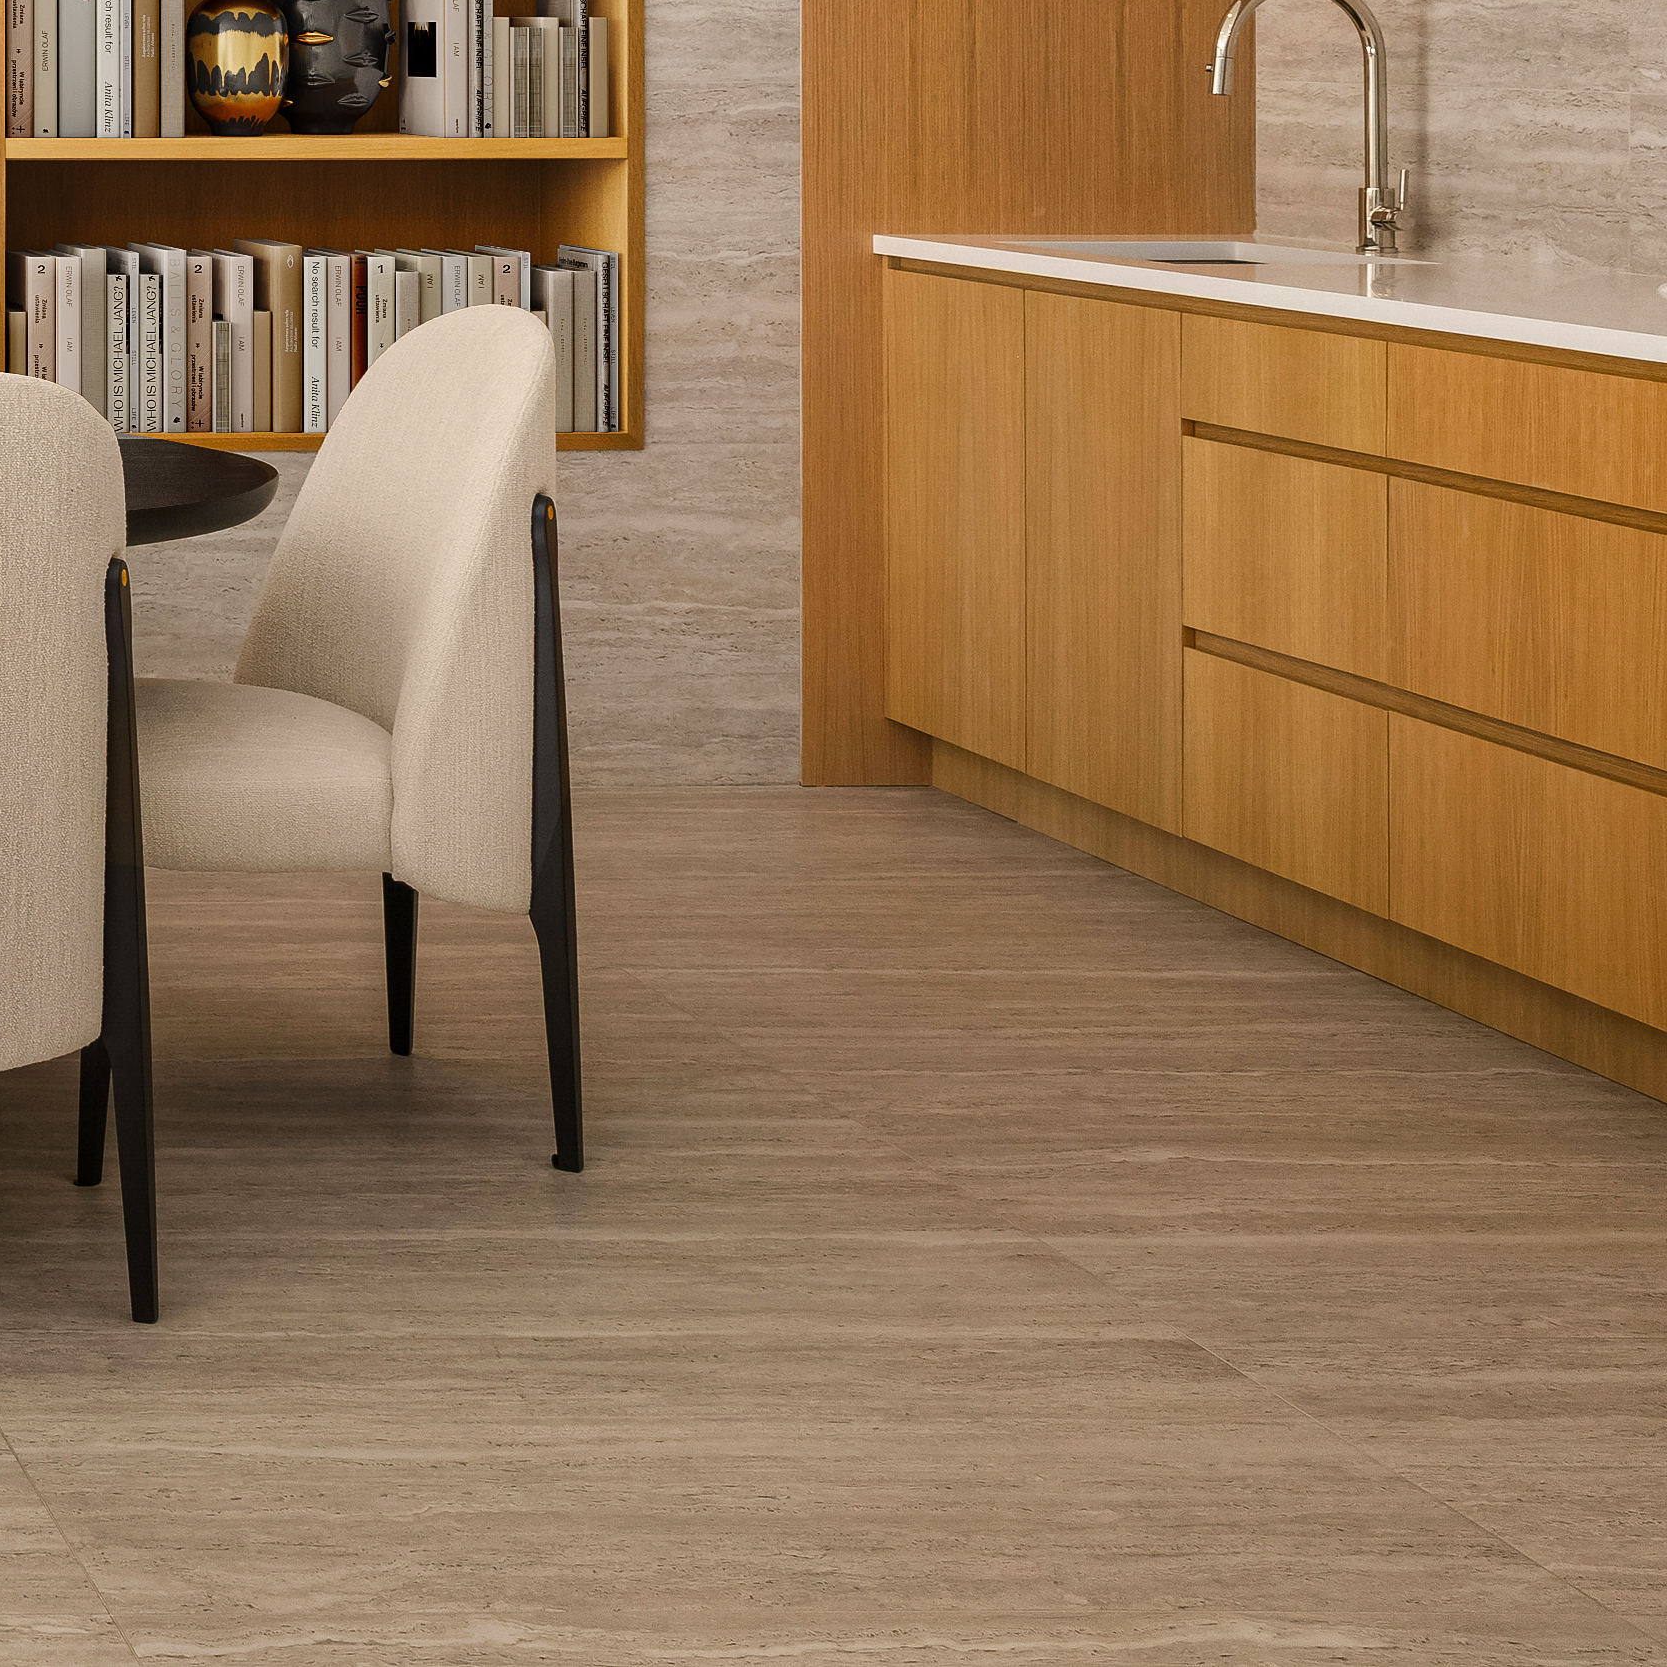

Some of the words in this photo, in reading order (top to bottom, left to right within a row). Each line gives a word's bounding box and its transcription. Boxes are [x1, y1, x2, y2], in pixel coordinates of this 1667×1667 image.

[377, 264, 384, 274] 1
[502, 264, 511, 274] 2
[113, 286, 123, 325] JANG?
[169, 326, 181, 334] &
[113, 327, 123, 382] MICHAEL
[113, 386, 123, 396] IS
[113, 400, 123, 432] WHO
